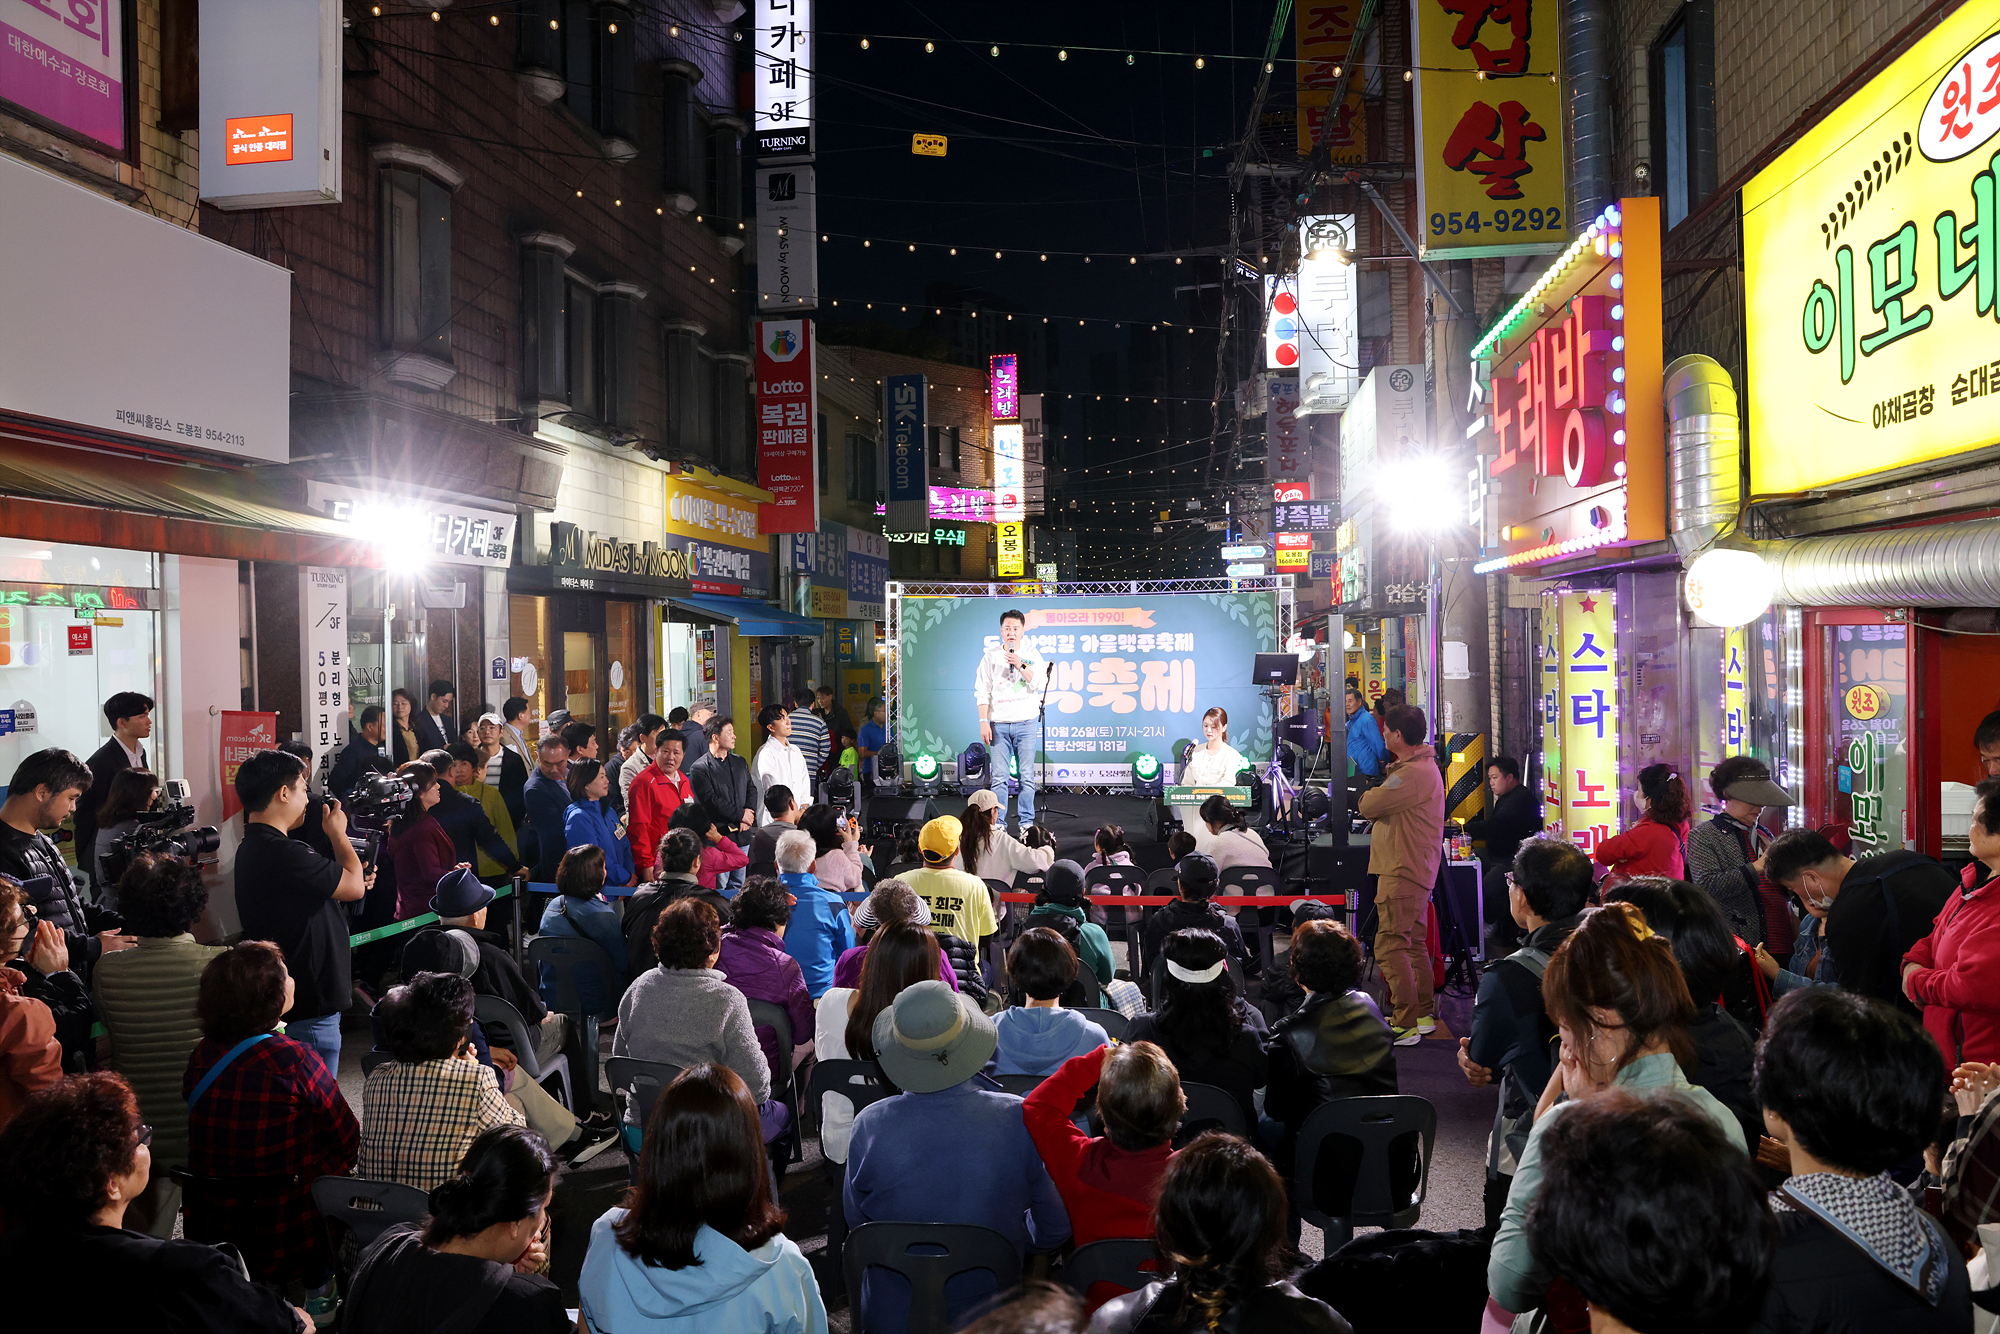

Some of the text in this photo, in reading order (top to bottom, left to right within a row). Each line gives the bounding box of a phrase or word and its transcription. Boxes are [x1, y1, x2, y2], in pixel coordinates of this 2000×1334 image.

[8, 33, 109, 98] 대한예수교 장로회
[769, 101, 796, 122] 3F
[232, 140, 287, 154] 공식 인증 대리점
[760, 136, 806, 148] TURNING
[1430, 207, 1562, 236] 954-9292
[780, 268, 790, 303] MOON
[763, 380, 804, 394] Lotto
[995, 368, 1015, 416] 노래방
[1490, 296, 1612, 487] 노래방
[762, 403, 807, 426] 복권
[1872, 384, 1935, 429] 야채곱창
[115, 409, 245, 446] 피앤씨홀딩스 도봉점 954-2113
[763, 428, 807, 445] 판매점
[894, 386, 916, 489] SK Telecom
[681, 494, 715, 530] 아이폰
[728, 507, 756, 539] 수리점
[492, 526, 504, 541] 3F
[1002, 525, 1018, 552] 오봉
[584, 531, 690, 580] MIDAS by MOON
[702, 546, 750, 580] 복권판매점
[311, 572, 343, 584] TURNING
[561, 577, 579, 588] 마이더스
[330, 617, 341, 629] 3F
[1045, 611, 1125, 624] 돌아오라 1990!
[72, 633, 88, 641] 에스원
[838, 627, 852, 655] 은혜
[331, 650, 341, 706] 분리형
[348, 667, 383, 686] NING
[496, 668, 503, 677] 14
[1037, 657, 1195, 714] 맥축제
[1545, 632, 1560, 739] 스타
[1570, 632, 1612, 740] 스타
[1727, 647, 1744, 757] 스타
[1851, 689, 1874, 714] 원조
[1046, 726, 1165, 737] 10월 26일(토) 17시~21시
[1045, 740, 1127, 751] 도봉산옛길 181길
[1072, 769, 1094, 777] 도봉구
[1849, 731, 1877, 860] 이모
[935, 896, 963, 910] 최강
